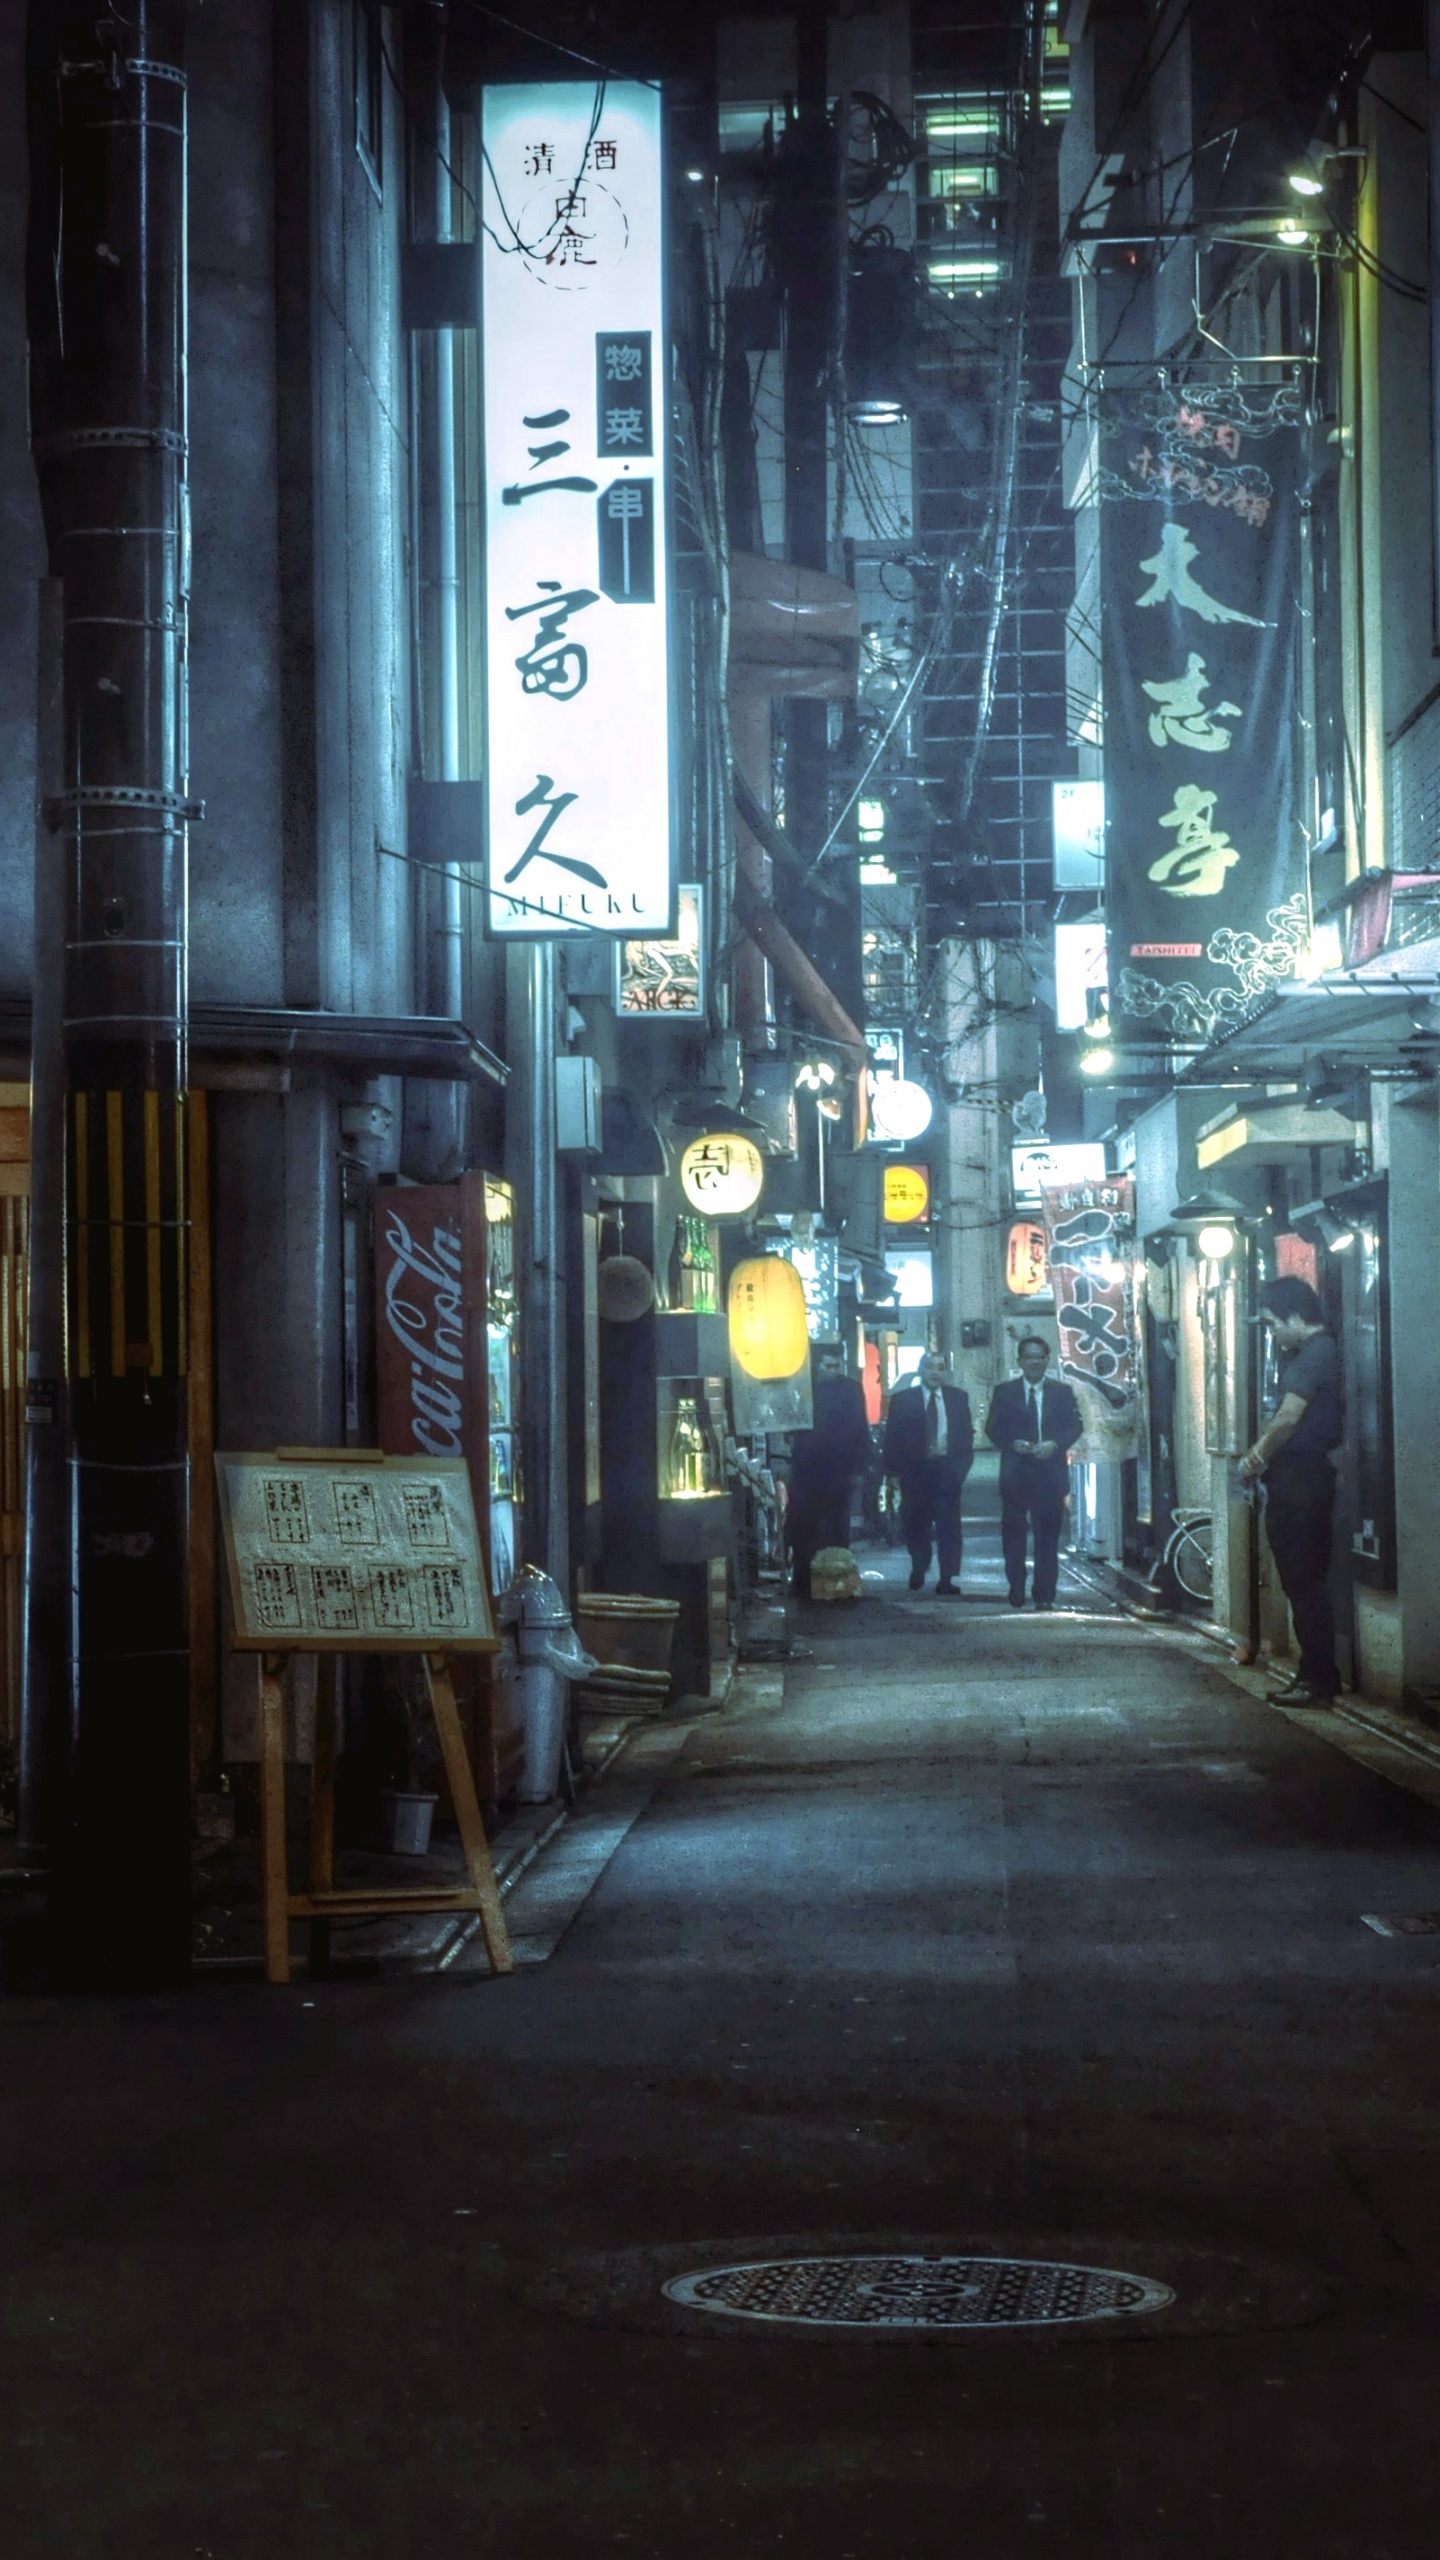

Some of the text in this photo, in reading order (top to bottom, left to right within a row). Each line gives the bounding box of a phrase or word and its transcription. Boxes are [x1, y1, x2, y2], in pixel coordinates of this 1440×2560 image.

[525, 140, 617, 176] 清酒
[502, 408, 608, 889] 三富久
[1135, 523, 1278, 897] 大志亭
[1061, 789, 1075, 799] 2F
[507, 892, 646, 917] MIFUKU
[386, 1208, 464, 1457] ca-Cola
